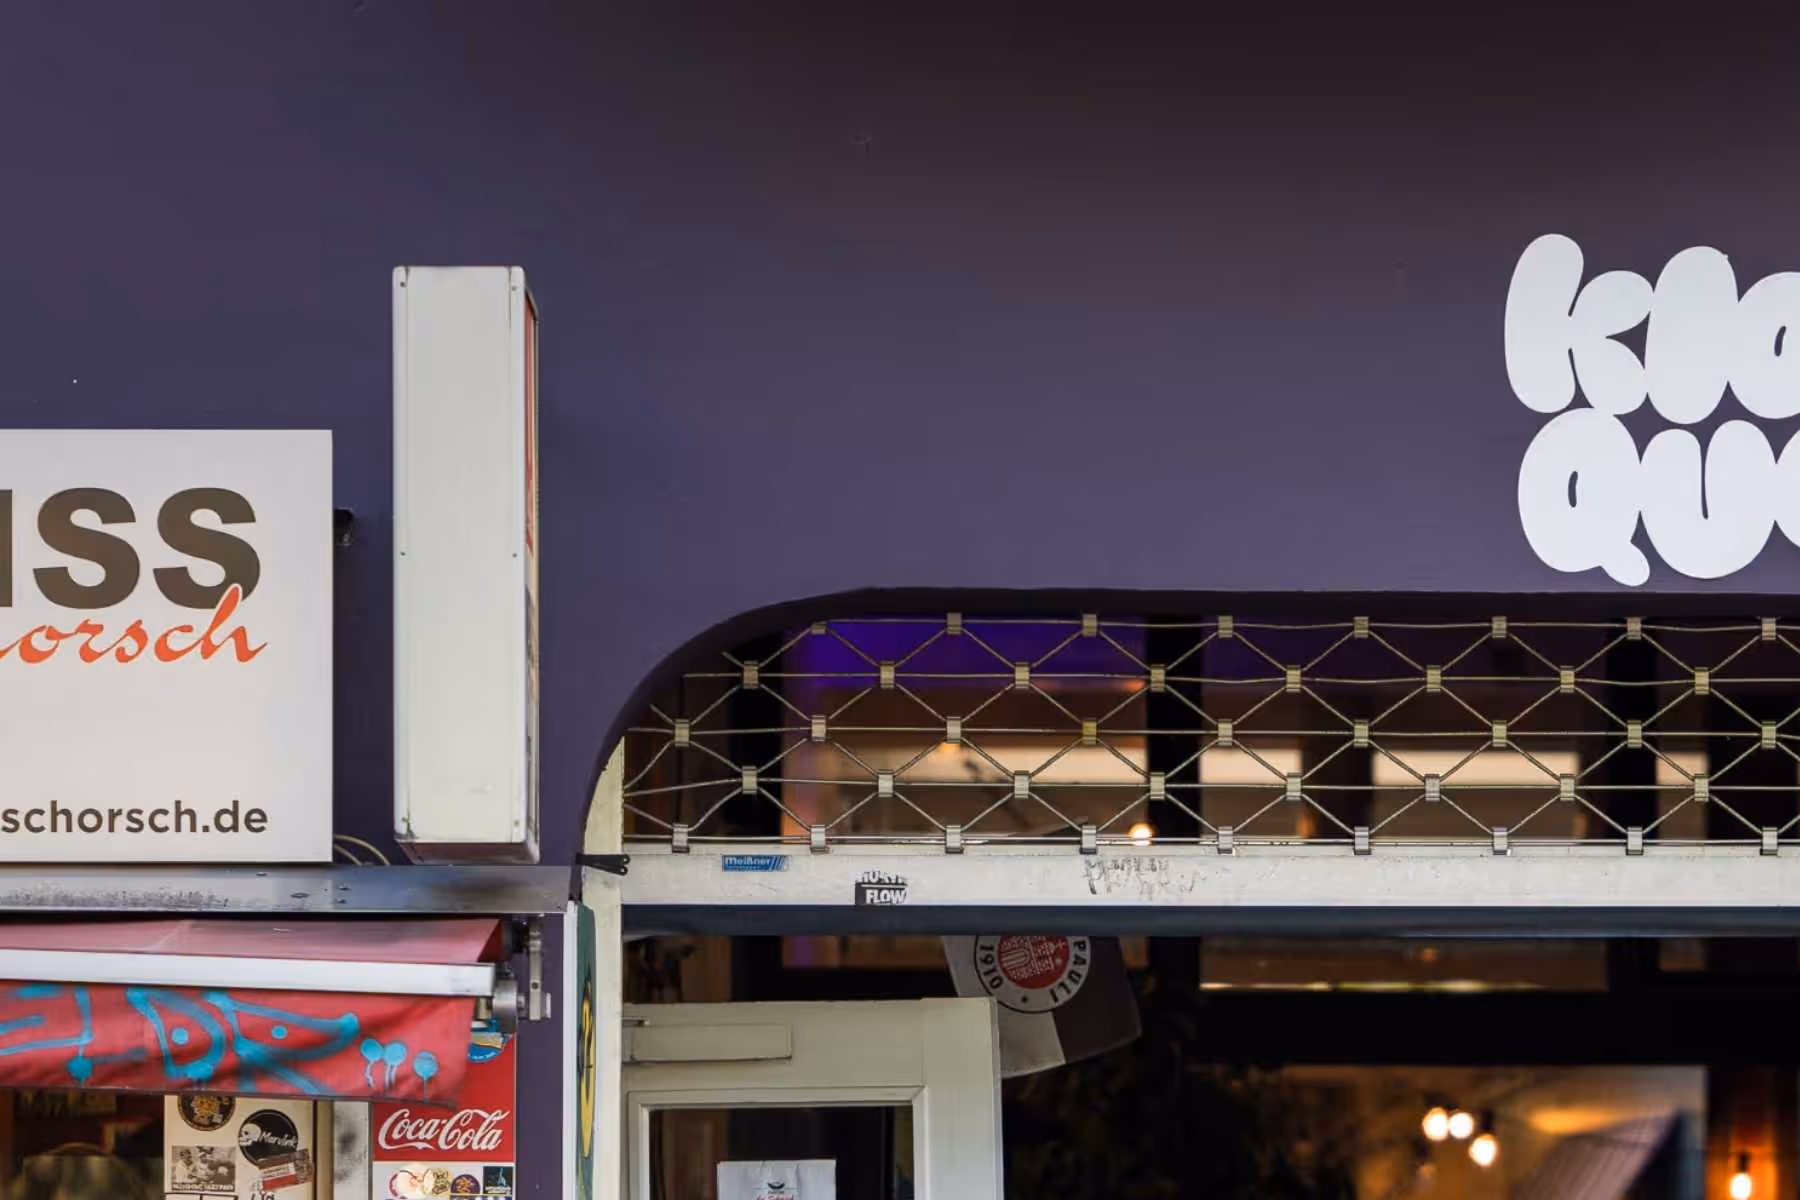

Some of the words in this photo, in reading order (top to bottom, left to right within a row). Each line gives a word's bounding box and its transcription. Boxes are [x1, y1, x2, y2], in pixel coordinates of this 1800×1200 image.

[865, 889, 908, 905] FLOW
[1049, 940, 1088, 1004] PAULI
[378, 1108, 511, 1151] Coca-Cola
